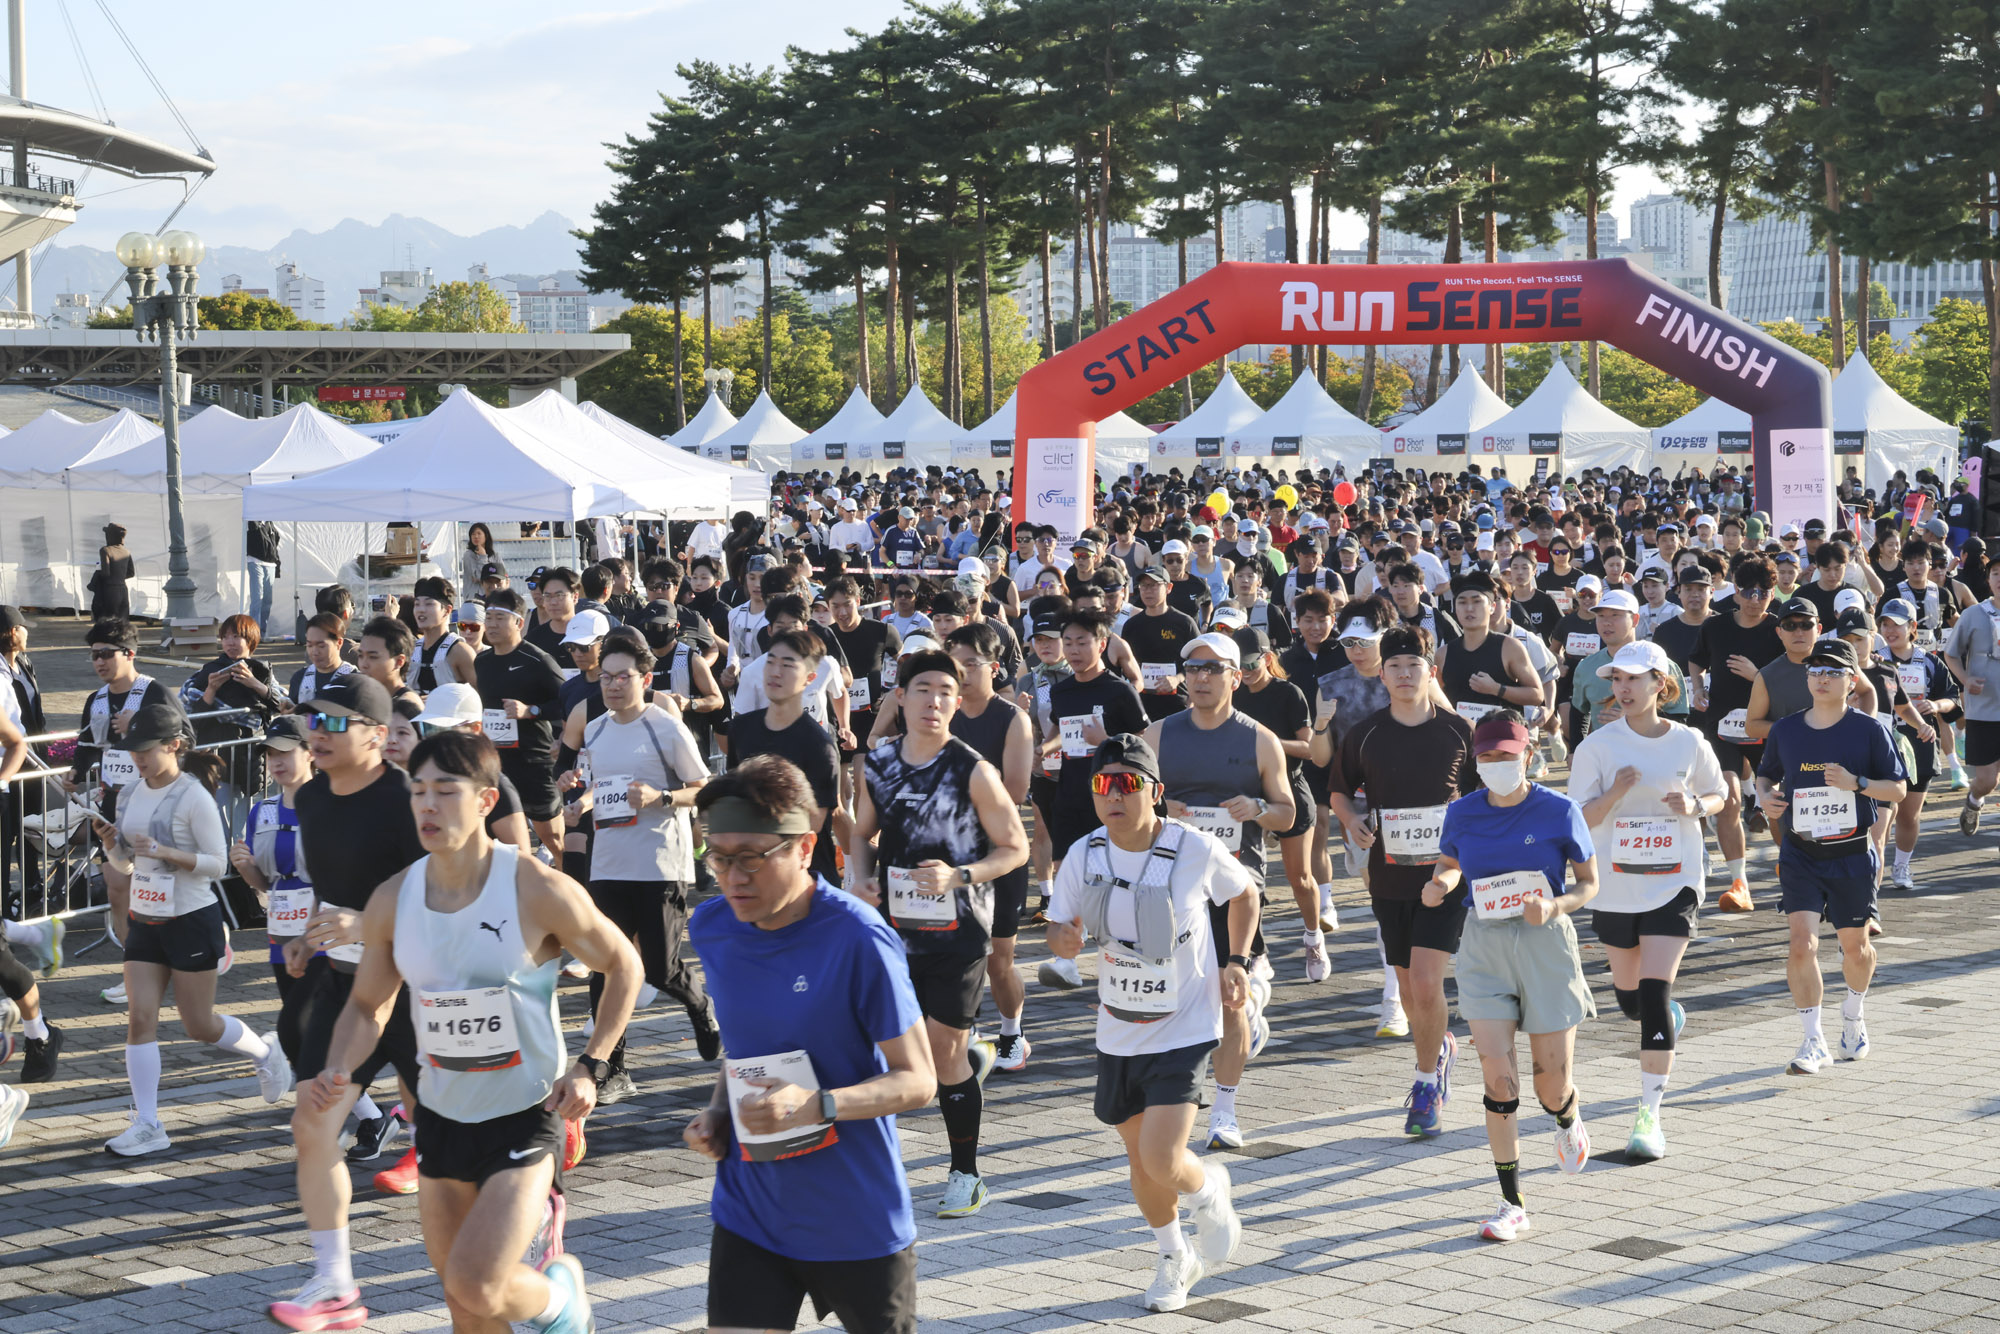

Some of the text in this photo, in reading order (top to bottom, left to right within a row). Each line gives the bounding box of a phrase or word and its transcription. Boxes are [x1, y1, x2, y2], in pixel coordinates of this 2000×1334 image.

[1445, 274, 1583, 286] RUN The Record, Feel The SENSE
[1083, 299, 1216, 396] START
[1635, 293, 1778, 389] FINISH
[1497, 436, 1515, 446] Short
[1672, 436, 1708, 449] 오늘덤핑
[1783, 484, 1823, 494] 경기떡집
[1576, 641, 1597, 649] 2132
[489, 722, 512, 731] 1224
[109, 764, 134, 774] 1753
[601, 791, 628, 805] 1804
[1800, 803, 1848, 816] M 1354
[1391, 826, 1440, 840] M 1301
[1619, 836, 1673, 849] W 2198
[137, 888, 166, 903] 2324
[894, 890, 903, 900] M
[1484, 900, 1496, 911] W
[276, 907, 308, 921] 2235
[1109, 975, 1167, 994] M 1154
[427, 1014, 502, 1036] M 1676
